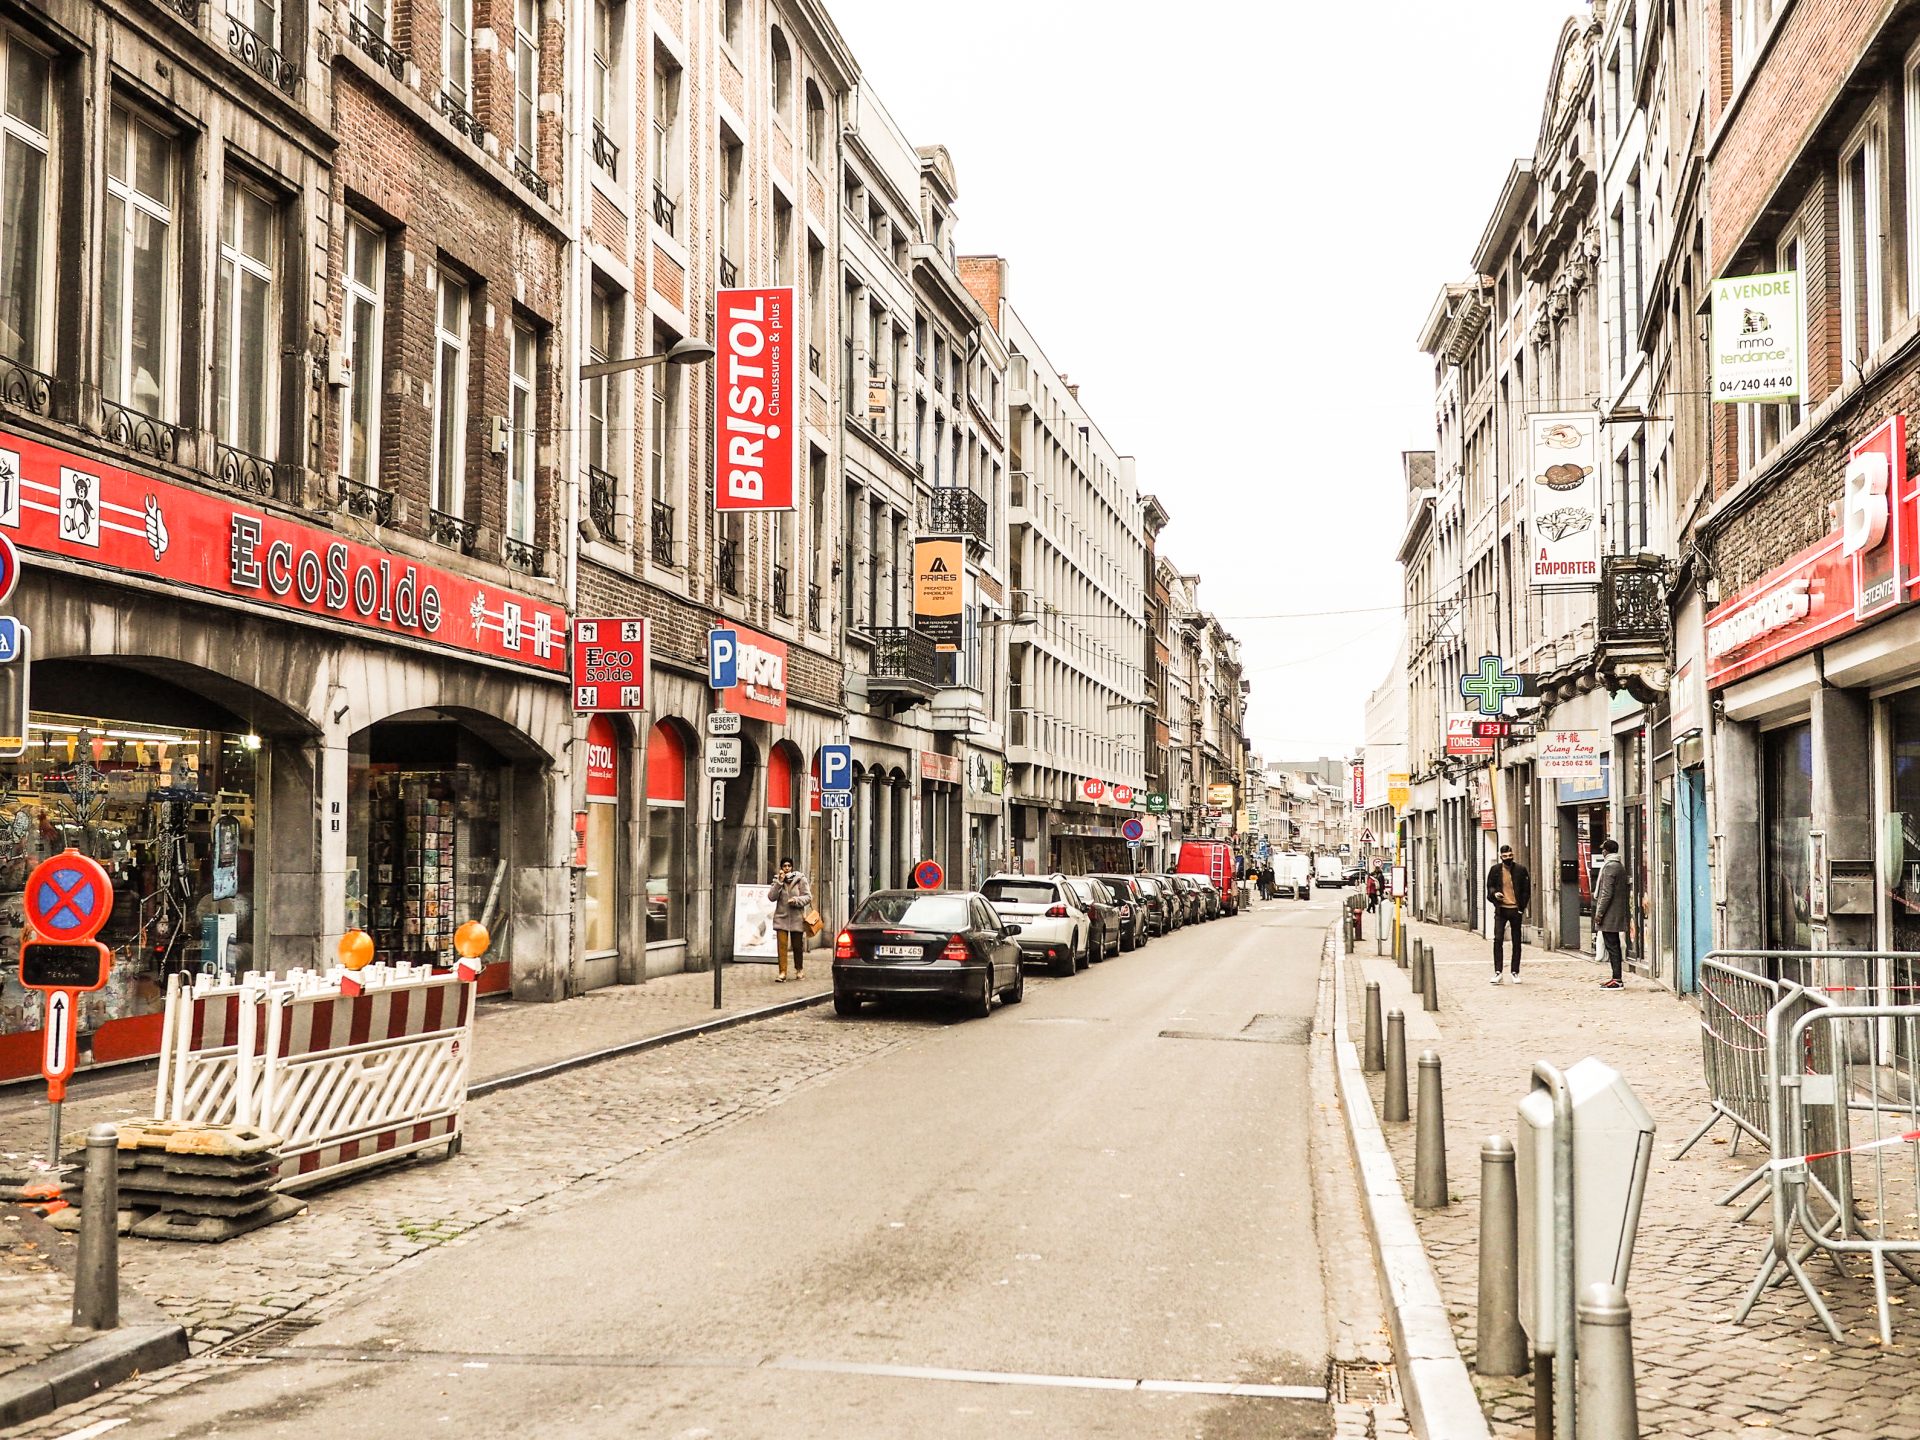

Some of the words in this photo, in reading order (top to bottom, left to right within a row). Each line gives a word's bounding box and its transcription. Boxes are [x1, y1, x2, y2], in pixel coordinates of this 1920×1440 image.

[1719, 287, 1729, 301] A
[1733, 280, 1790, 300] VENDRE
[768, 333, 780, 342] &
[1737, 337, 1774, 349] immo
[1720, 349, 1785, 365] tendance
[768, 345, 780, 416] Chaussures
[1719, 378, 1760, 392] 04/240
[1763, 377, 1776, 389] 44
[1779, 375, 1792, 387] 40
[727, 296, 767, 500] BRISTOL
[1842, 452, 1888, 558] B
[1540, 547, 1547, 560] A
[231, 512, 441, 633] EcoSolde
[1535, 561, 1596, 575] EMPORTER
[585, 646, 633, 667] Eco
[713, 639, 733, 680] P
[585, 667, 633, 683] Solde
[1480, 724, 1509, 736] 13:31
[1450, 737, 1480, 747] TONERS
[1543, 744, 1571, 754] Xiang
[1575, 744, 1594, 754] Long
[825, 752, 847, 784] P
[1087, 783, 1102, 794] di!
[1116, 789, 1130, 799] di!
[824, 794, 848, 807] TICKET
